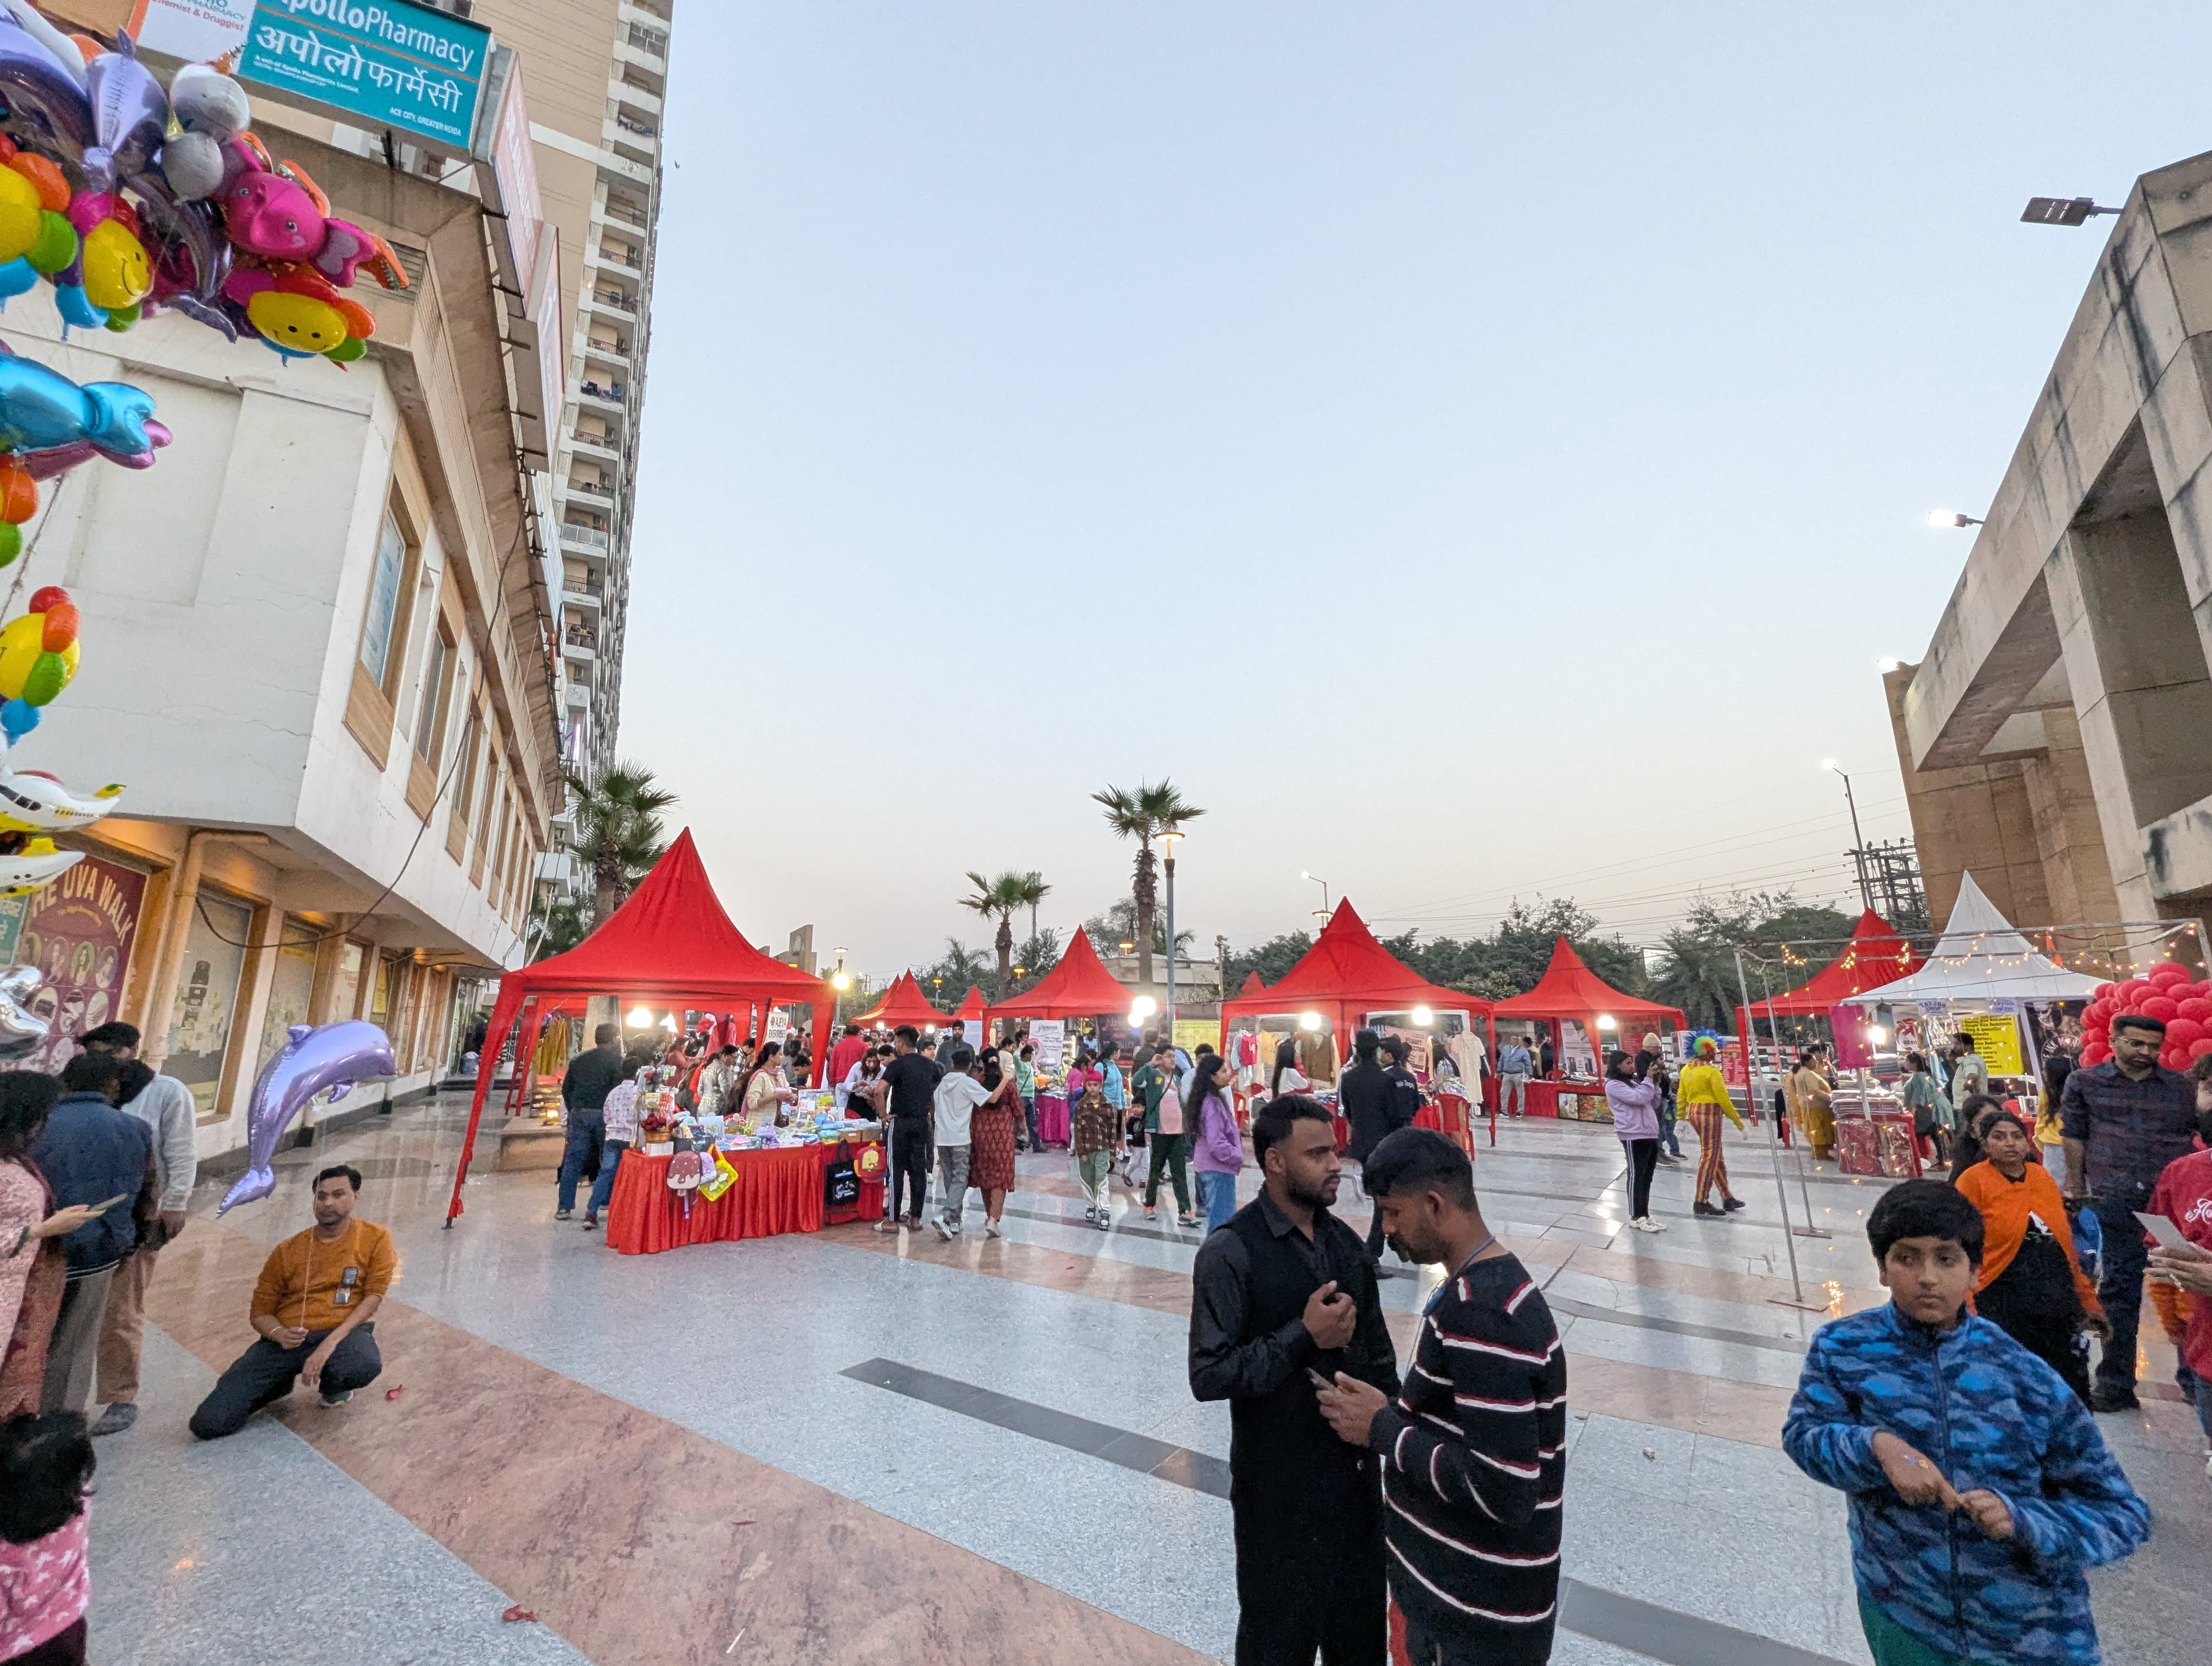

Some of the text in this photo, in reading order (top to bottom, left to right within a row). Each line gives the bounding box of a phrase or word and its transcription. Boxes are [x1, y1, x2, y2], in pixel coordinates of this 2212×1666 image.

[193, 8, 200, 17] &
[203, 11, 244, 31] Druggist
[281, 0, 474, 72] polloPharmacy
[256, 25, 366, 81] अपोलो
[368, 61, 463, 114] फार्मेसी
[390, 107, 402, 117] ACE
[63, 864, 98, 901] UVA
[99, 875, 133, 947] WALK
